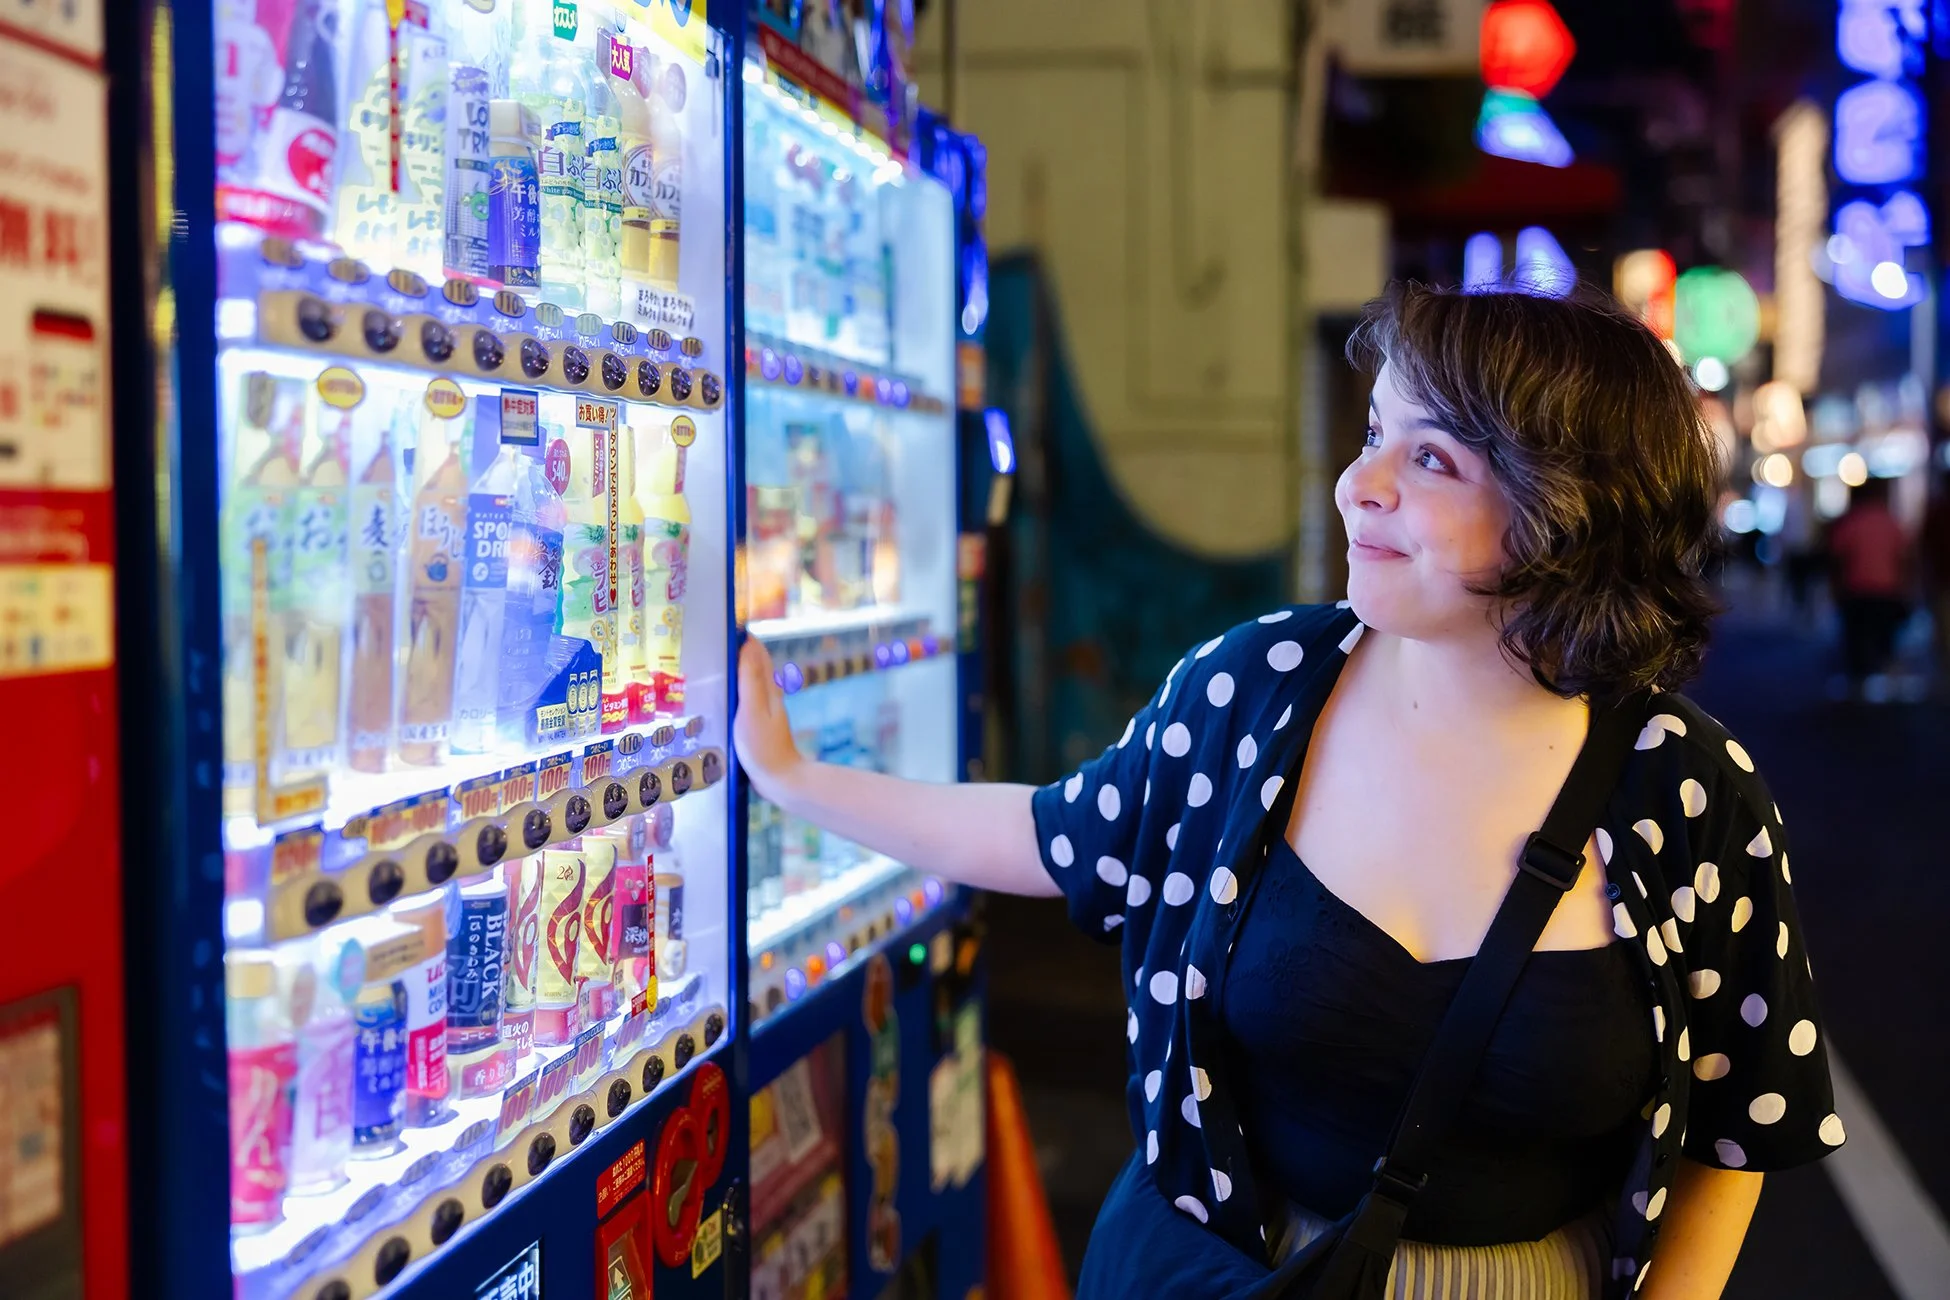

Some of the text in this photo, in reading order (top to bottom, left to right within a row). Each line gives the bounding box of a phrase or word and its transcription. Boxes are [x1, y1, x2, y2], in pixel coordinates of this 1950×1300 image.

[554, 6, 577, 29] オススメ
[611, 47, 631, 74] 大人気
[473, 521, 513, 541] SPO
[481, 914, 504, 1000] BLACK
